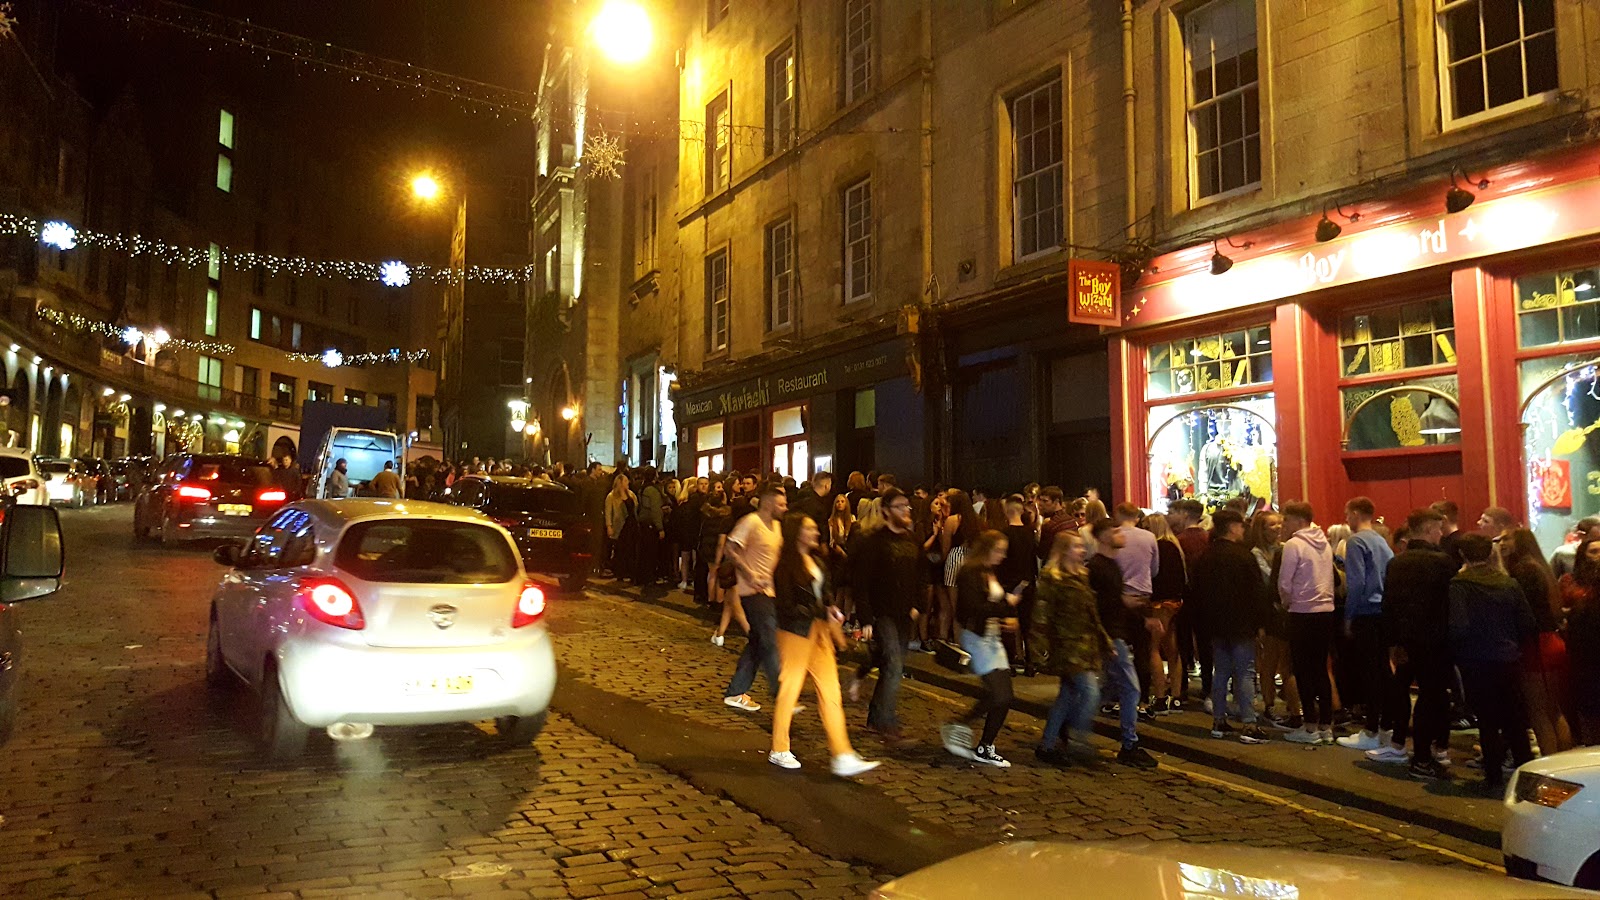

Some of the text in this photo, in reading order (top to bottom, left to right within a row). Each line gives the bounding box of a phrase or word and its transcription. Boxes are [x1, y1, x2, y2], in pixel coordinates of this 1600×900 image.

[1299, 249, 1344, 284] Boy
[1078, 275, 1112, 295] The Boy
[1078, 291, 1113, 308] Wizard
[686, 370, 828, 415] Mexican Mariachi Restaurant
